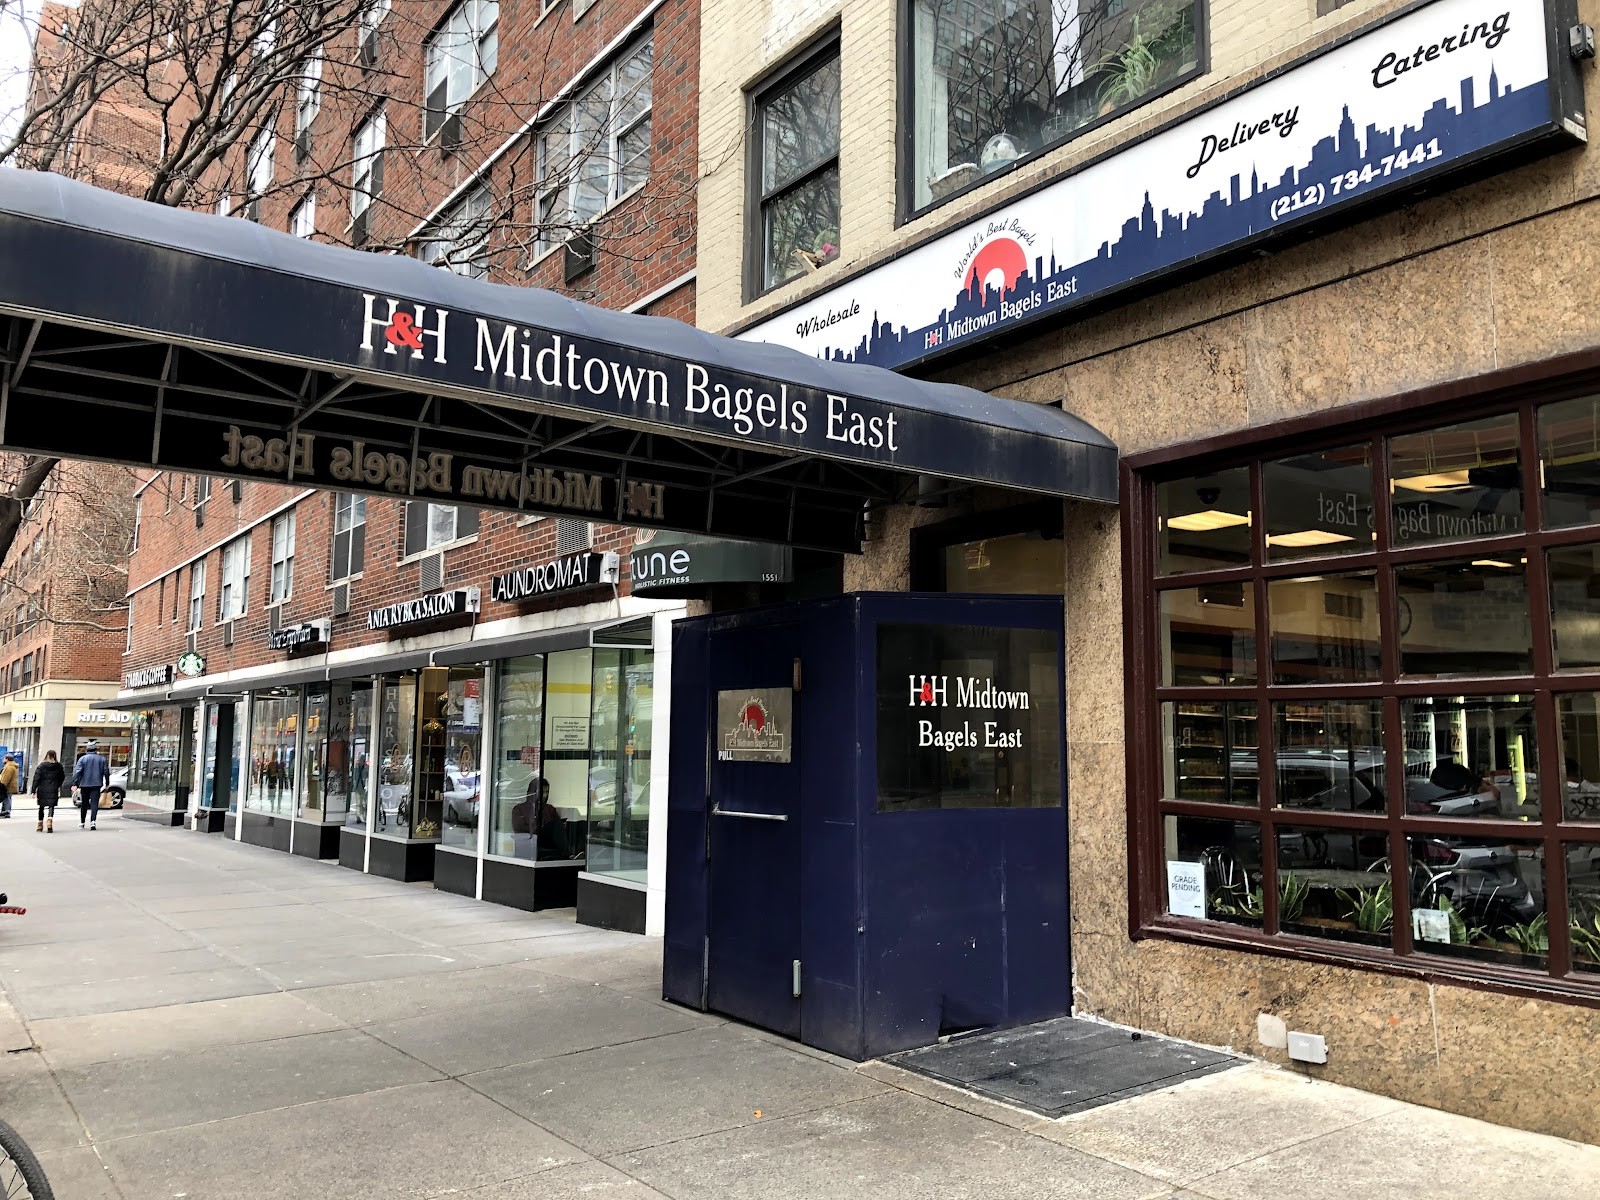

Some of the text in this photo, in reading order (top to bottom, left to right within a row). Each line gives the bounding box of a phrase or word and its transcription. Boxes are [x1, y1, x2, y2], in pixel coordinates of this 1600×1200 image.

[1371, 11, 1510, 89] Catering
[1186, 105, 1299, 179] Delivery
[1270, 138, 1443, 220] (212) 734-7441
[953, 218, 1037, 279] World's Best Bagels
[796, 298, 860, 339] Wholesale
[924, 276, 1078, 350] H&H Midtown Bagels East
[359, 293, 898, 451] H&H Midtown Bagels East
[490, 552, 591, 602] LAUNDROMAT
[630, 549, 691, 582] tune
[659, 576, 690, 585] FITNESS
[762, 573, 778, 582] 1551
[366, 590, 456, 630] ANIA RYBKA SALON
[909, 675, 1029, 709] H&H Midtown
[78, 711, 130, 724] RITE AID
[918, 720, 1023, 752] Bagels East
[718, 751, 733, 761] PULL
[1171, 883, 1201, 893] PENDING
[1173, 875, 1197, 884] GRADE
